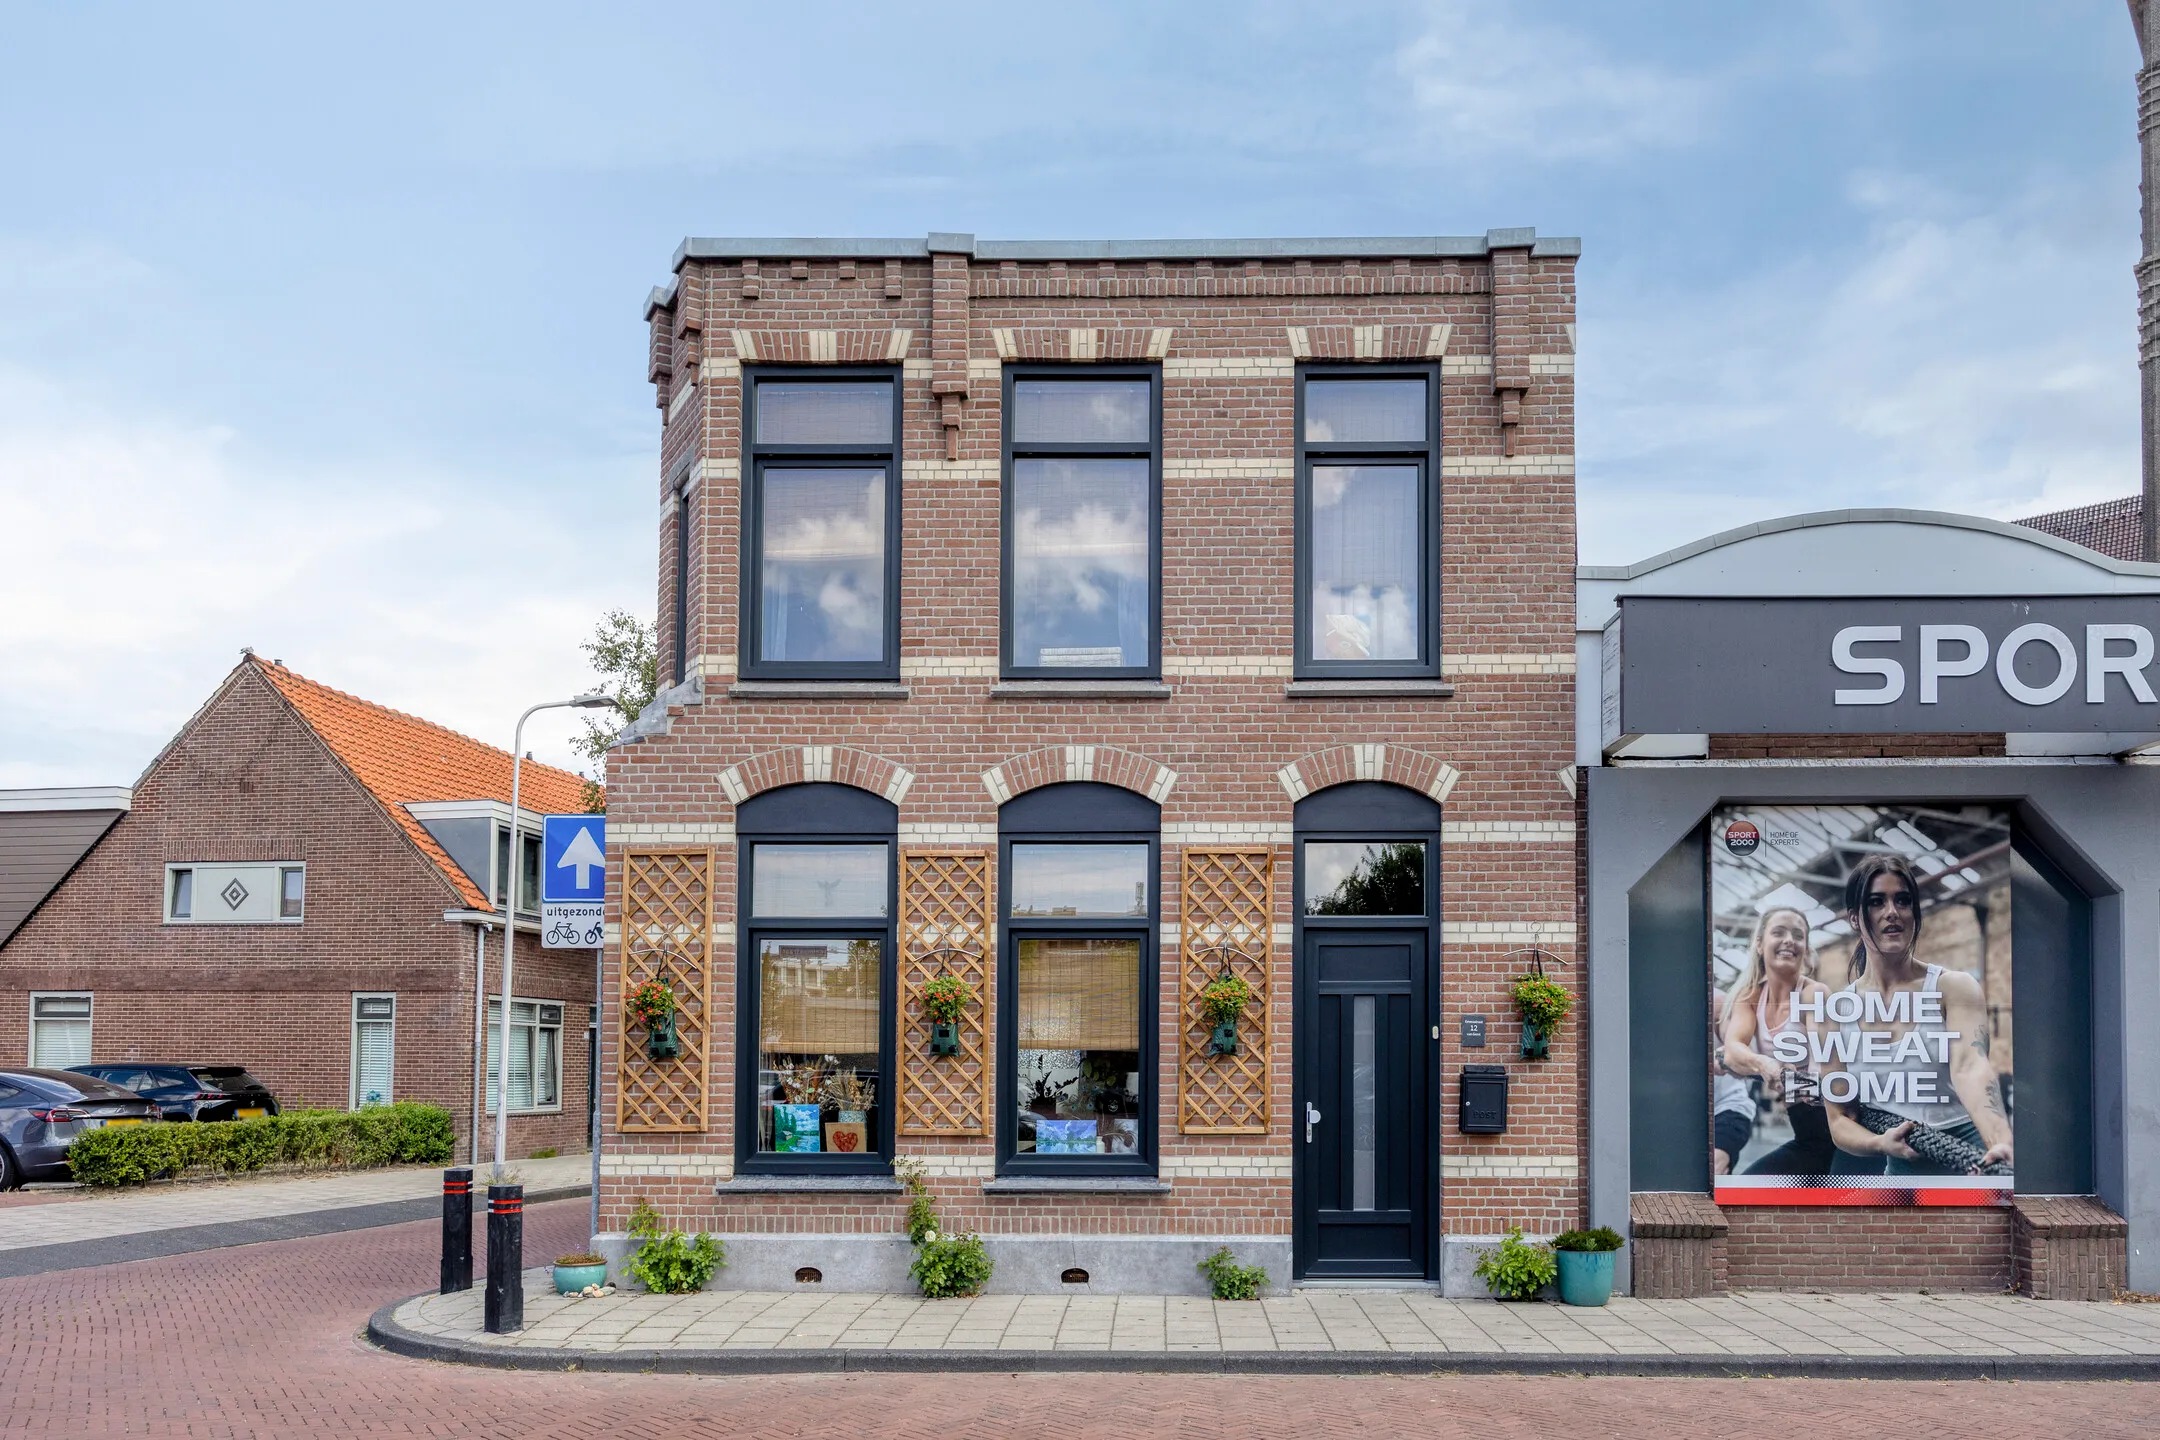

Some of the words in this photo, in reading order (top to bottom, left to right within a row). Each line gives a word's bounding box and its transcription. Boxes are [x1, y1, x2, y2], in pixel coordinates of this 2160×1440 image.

[1832, 622, 2158, 705] SPOR
[547, 907, 605, 919] uitgezond
[1790, 991, 1943, 1023] HOME
[1773, 1031, 1961, 1063] SWEAT
[1785, 1071, 1949, 1103] HOME.
[1473, 1111, 1497, 1119] POST
